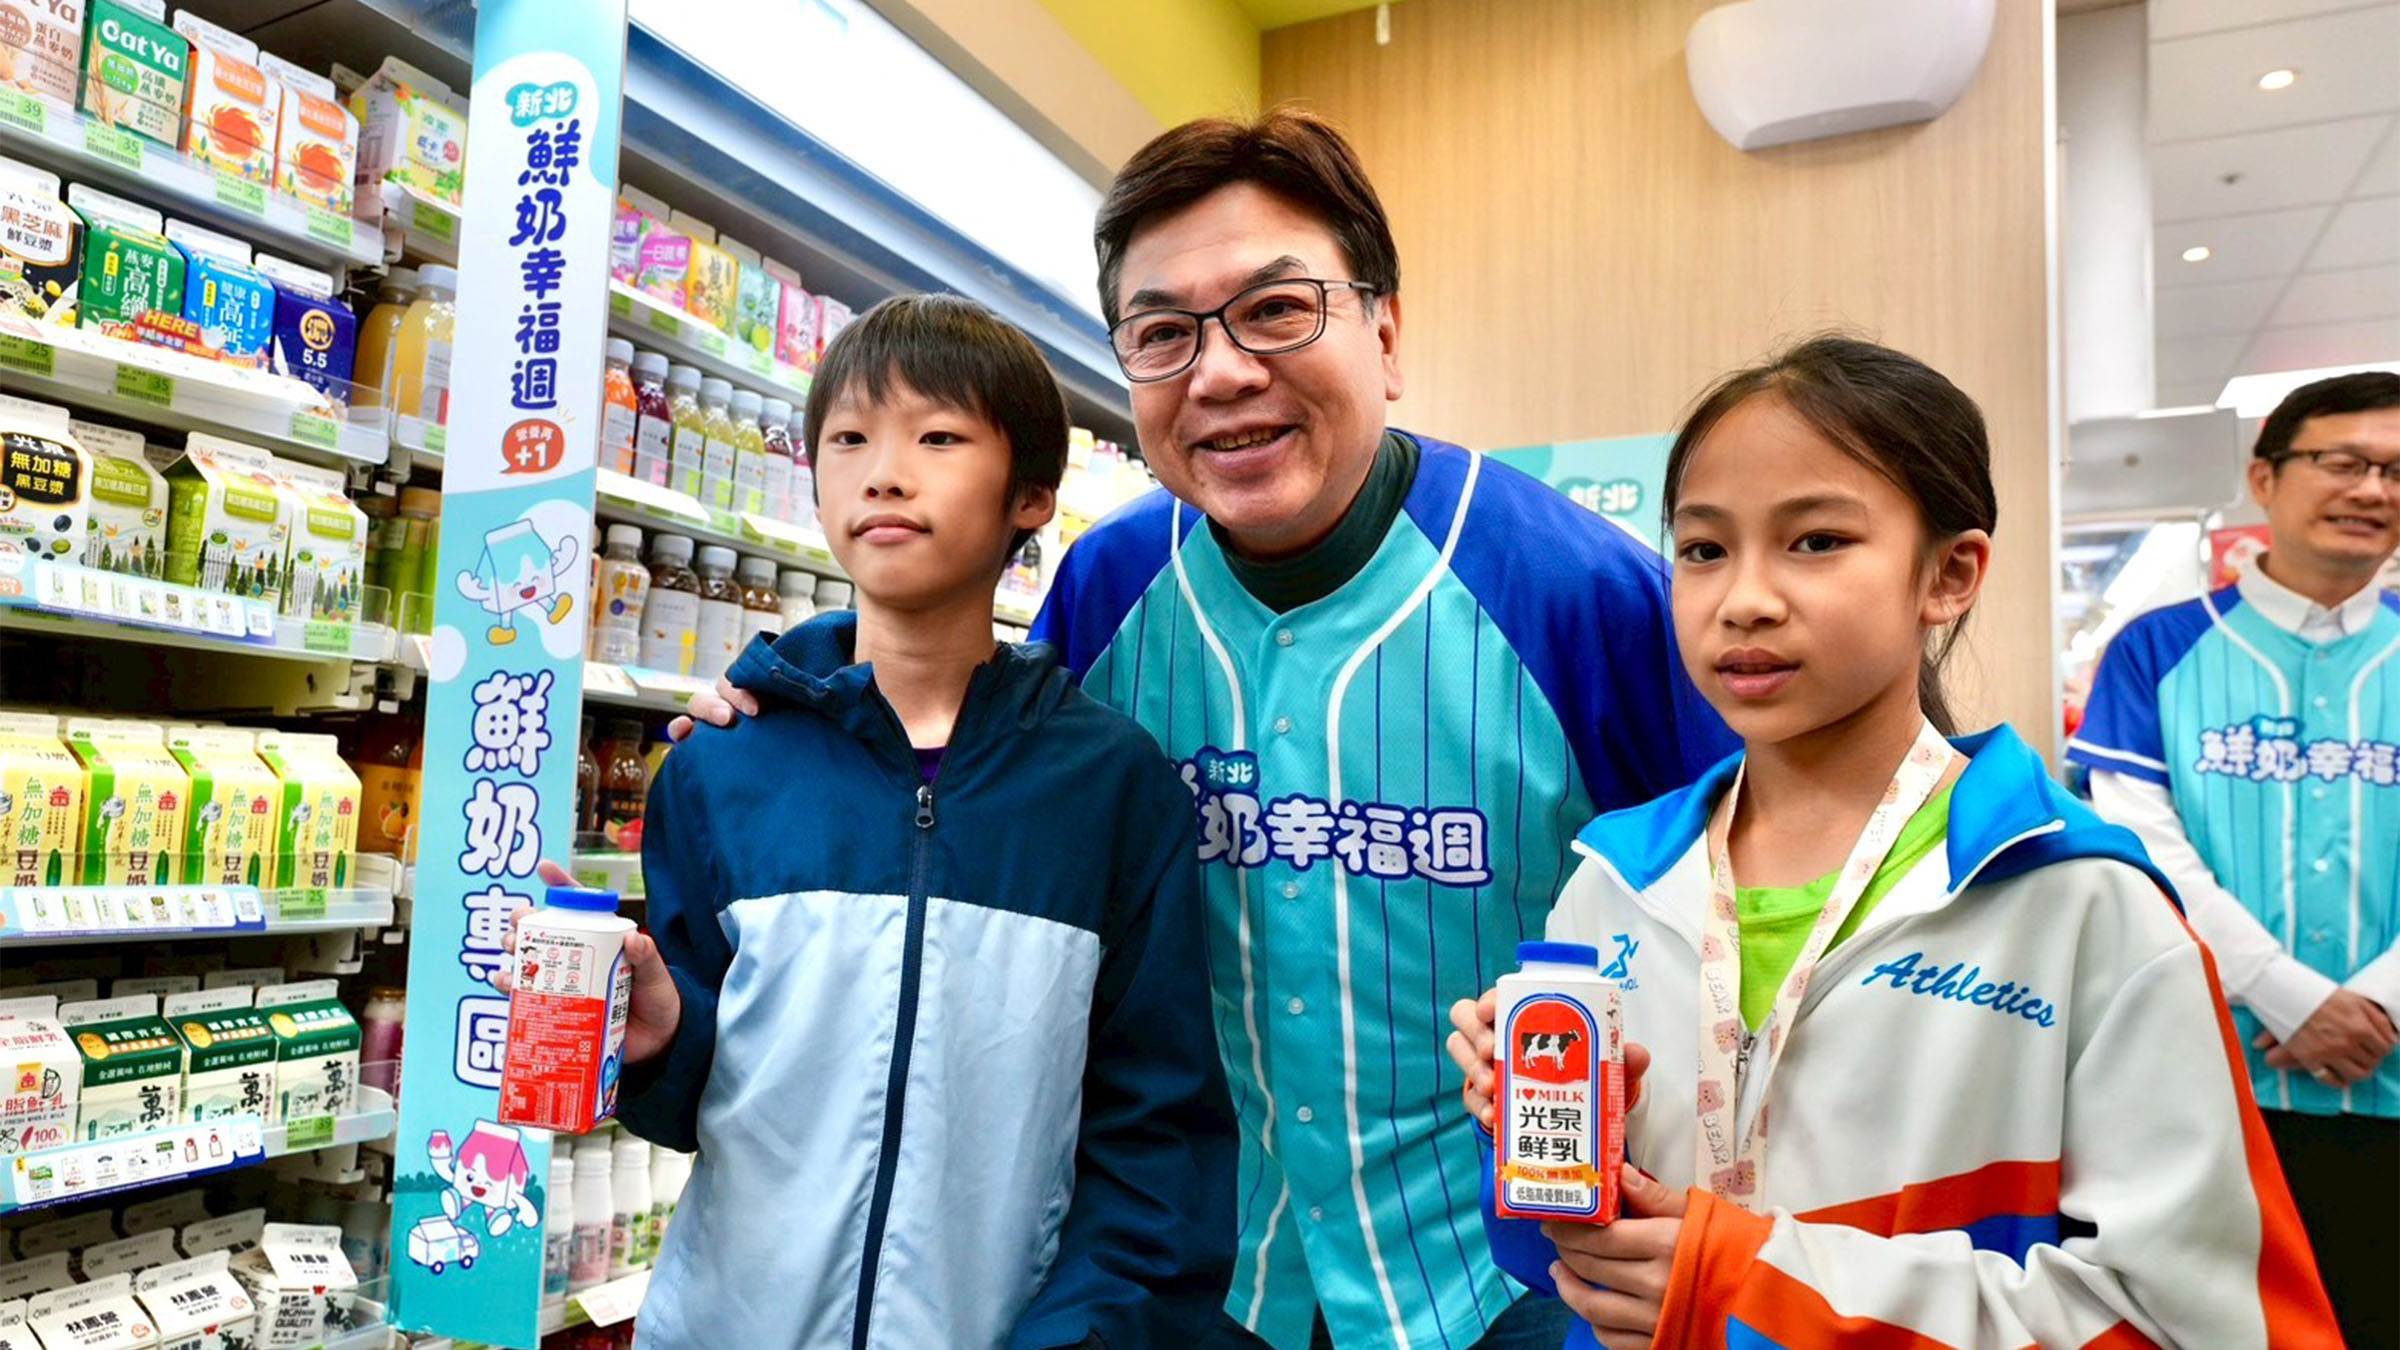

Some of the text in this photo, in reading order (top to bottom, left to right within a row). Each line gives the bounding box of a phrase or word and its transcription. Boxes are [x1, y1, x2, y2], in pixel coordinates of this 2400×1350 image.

[101, 19, 180, 71] Oat Ya
[22, 99, 42, 118] 39
[516, 87, 574, 118] 新北
[1, 205, 63, 240] 黑芝麻
[7, 227, 53, 252] 鮮豆漿
[124, 249, 154, 269] 燕麥
[509, 119, 583, 411] 鮮奶幸福週
[144, 309, 198, 339] HERE
[31, 342, 49, 358] 25
[303, 347, 328, 369] 5.5
[153, 378, 169, 392] 35
[10, 450, 72, 479] 無加糖
[515, 441, 547, 467] +1
[15, 472, 65, 497] 黑豆漿
[2195, 722, 2400, 787] 鮮奶幸福
[1207, 757, 1256, 785] 新北
[1178, 762, 1490, 884] 奶幸福週
[454, 669, 555, 1090] 鮮奶專區
[309, 890, 324, 902] 25
[1705, 967, 1732, 1015] BEAR
[1861, 951, 2056, 1030] Athletics
[0, 1092, 68, 1116] 脂鮮乳
[1519, 1105, 1582, 1132] 光泉
[1518, 1135, 1583, 1163] 鮮乳
[1703, 1112, 1730, 1166] BEAR
[65, 1310, 120, 1334] 林鳳營
[274, 1318, 314, 1329] QUALITY
